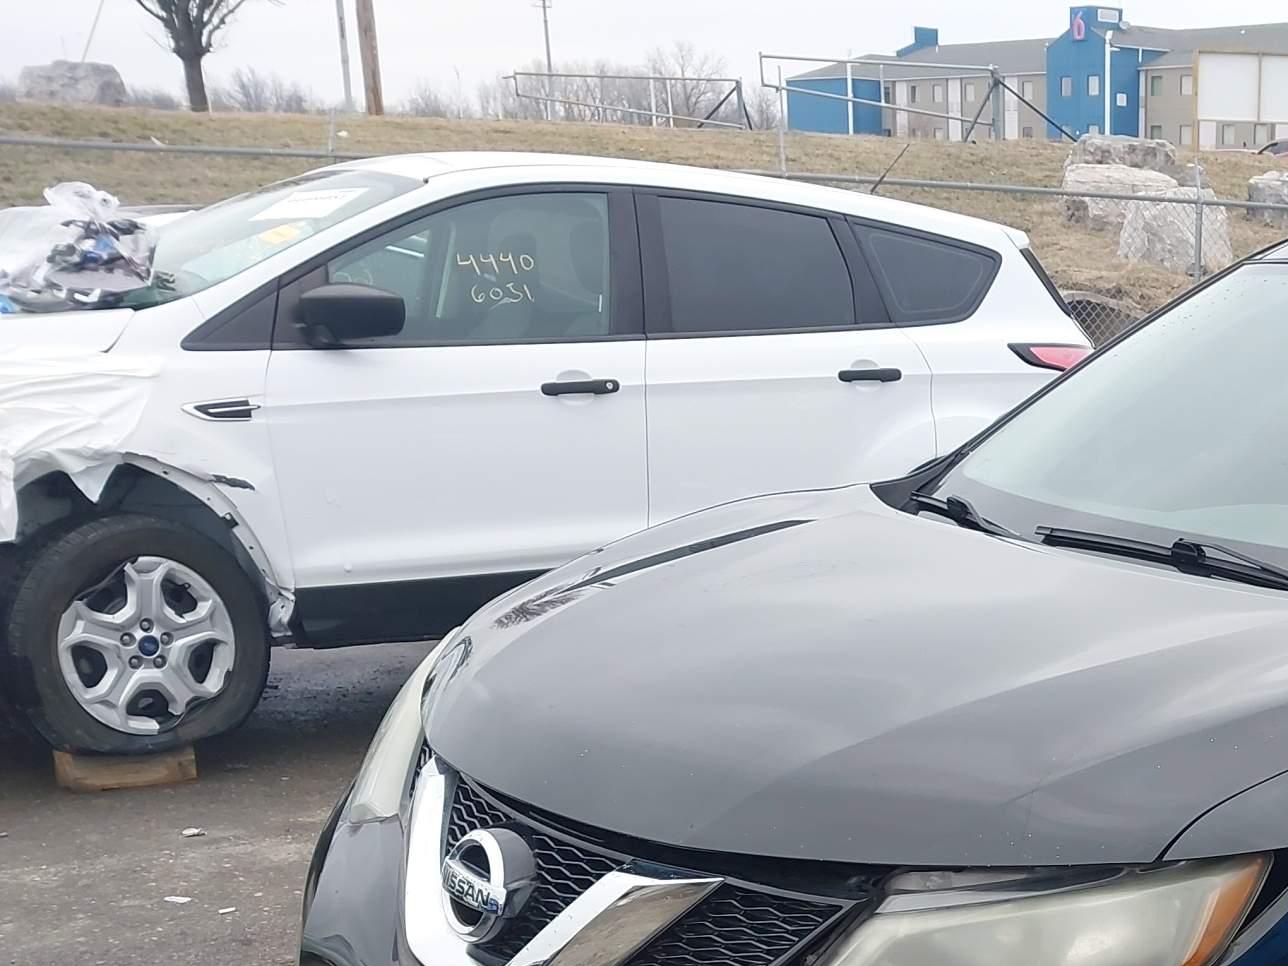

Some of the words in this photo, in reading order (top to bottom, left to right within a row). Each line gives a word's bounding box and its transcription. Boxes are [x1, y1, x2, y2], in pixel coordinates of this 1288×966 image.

[1072, 11, 1085, 40] 6
[457, 252, 535, 275] 4440
[443, 862, 491, 908] NISSAN
